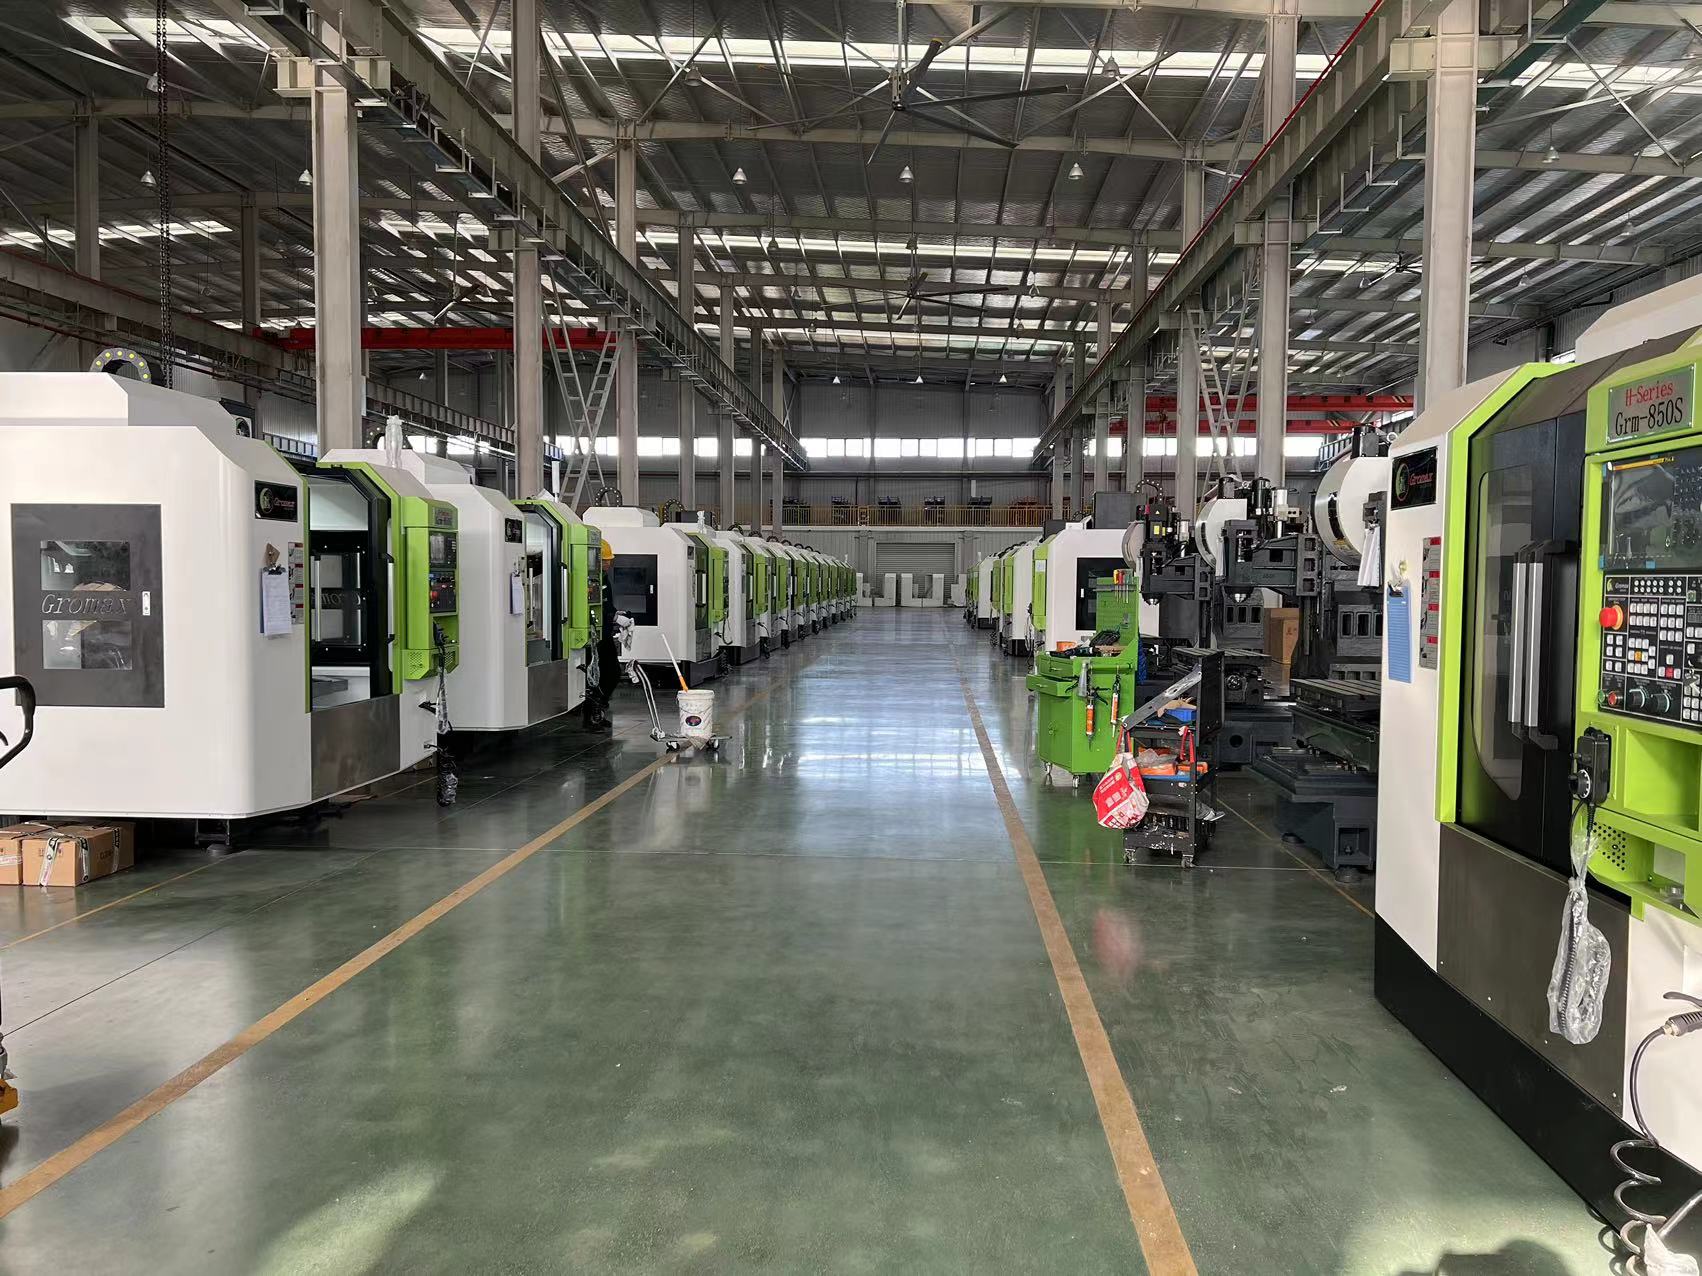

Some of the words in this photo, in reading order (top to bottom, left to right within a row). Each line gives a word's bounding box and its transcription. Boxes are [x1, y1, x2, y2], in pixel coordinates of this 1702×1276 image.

[1625, 381, 1674, 407] H-Series
[1616, 397, 1683, 436] Grm-850S
[41, 594, 131, 614] Gromax
